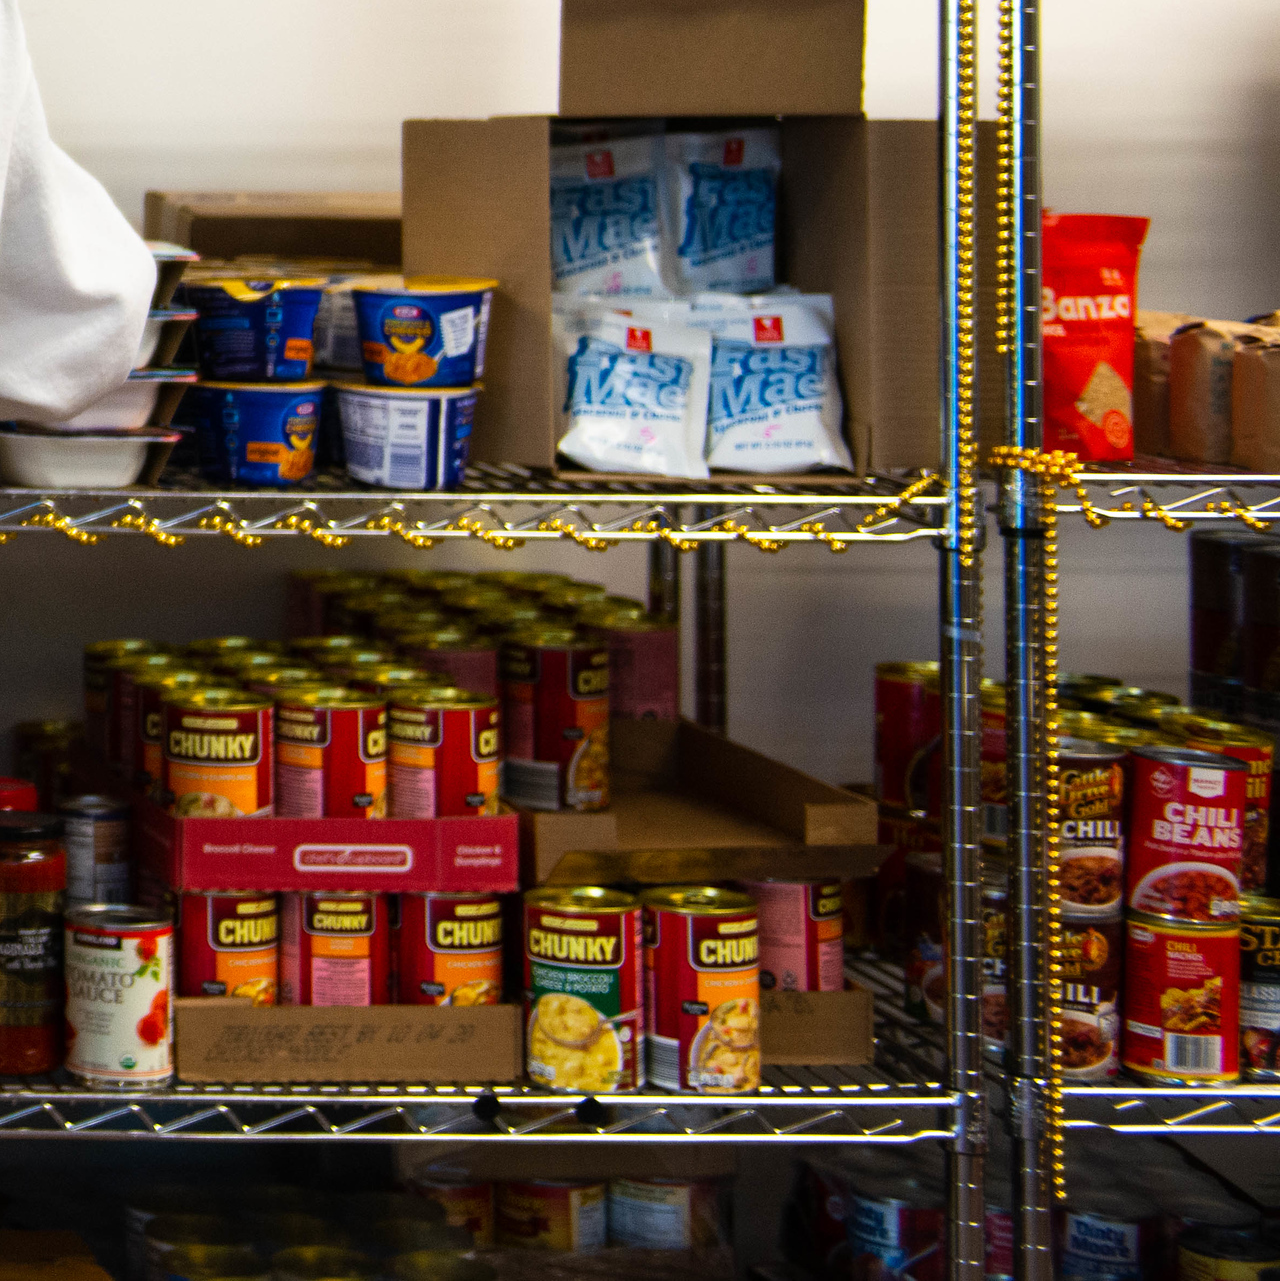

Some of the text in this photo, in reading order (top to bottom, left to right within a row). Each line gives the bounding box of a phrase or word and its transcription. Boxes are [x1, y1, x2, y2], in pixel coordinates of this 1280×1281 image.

[169, 732, 255, 760] CHUNKY
[1059, 768, 1111, 785] Cattle
[1068, 799, 1109, 819] Gold
[1163, 802, 1238, 827] CHILI
[1061, 820, 1121, 839] CHILI
[1152, 819, 1241, 848] BEANS
[218, 915, 277, 945] CHUN
[312, 914, 369, 931] CHUNKY
[436, 919, 502, 947] CHUN
[529, 928, 617, 961] CHUNKY
[1166, 940, 1197, 952] CHILI
[1166, 951, 1203, 961] NACHOS
[566, 971, 614, 985] BROCCOLI
[575, 983, 610, 994] POTATO
